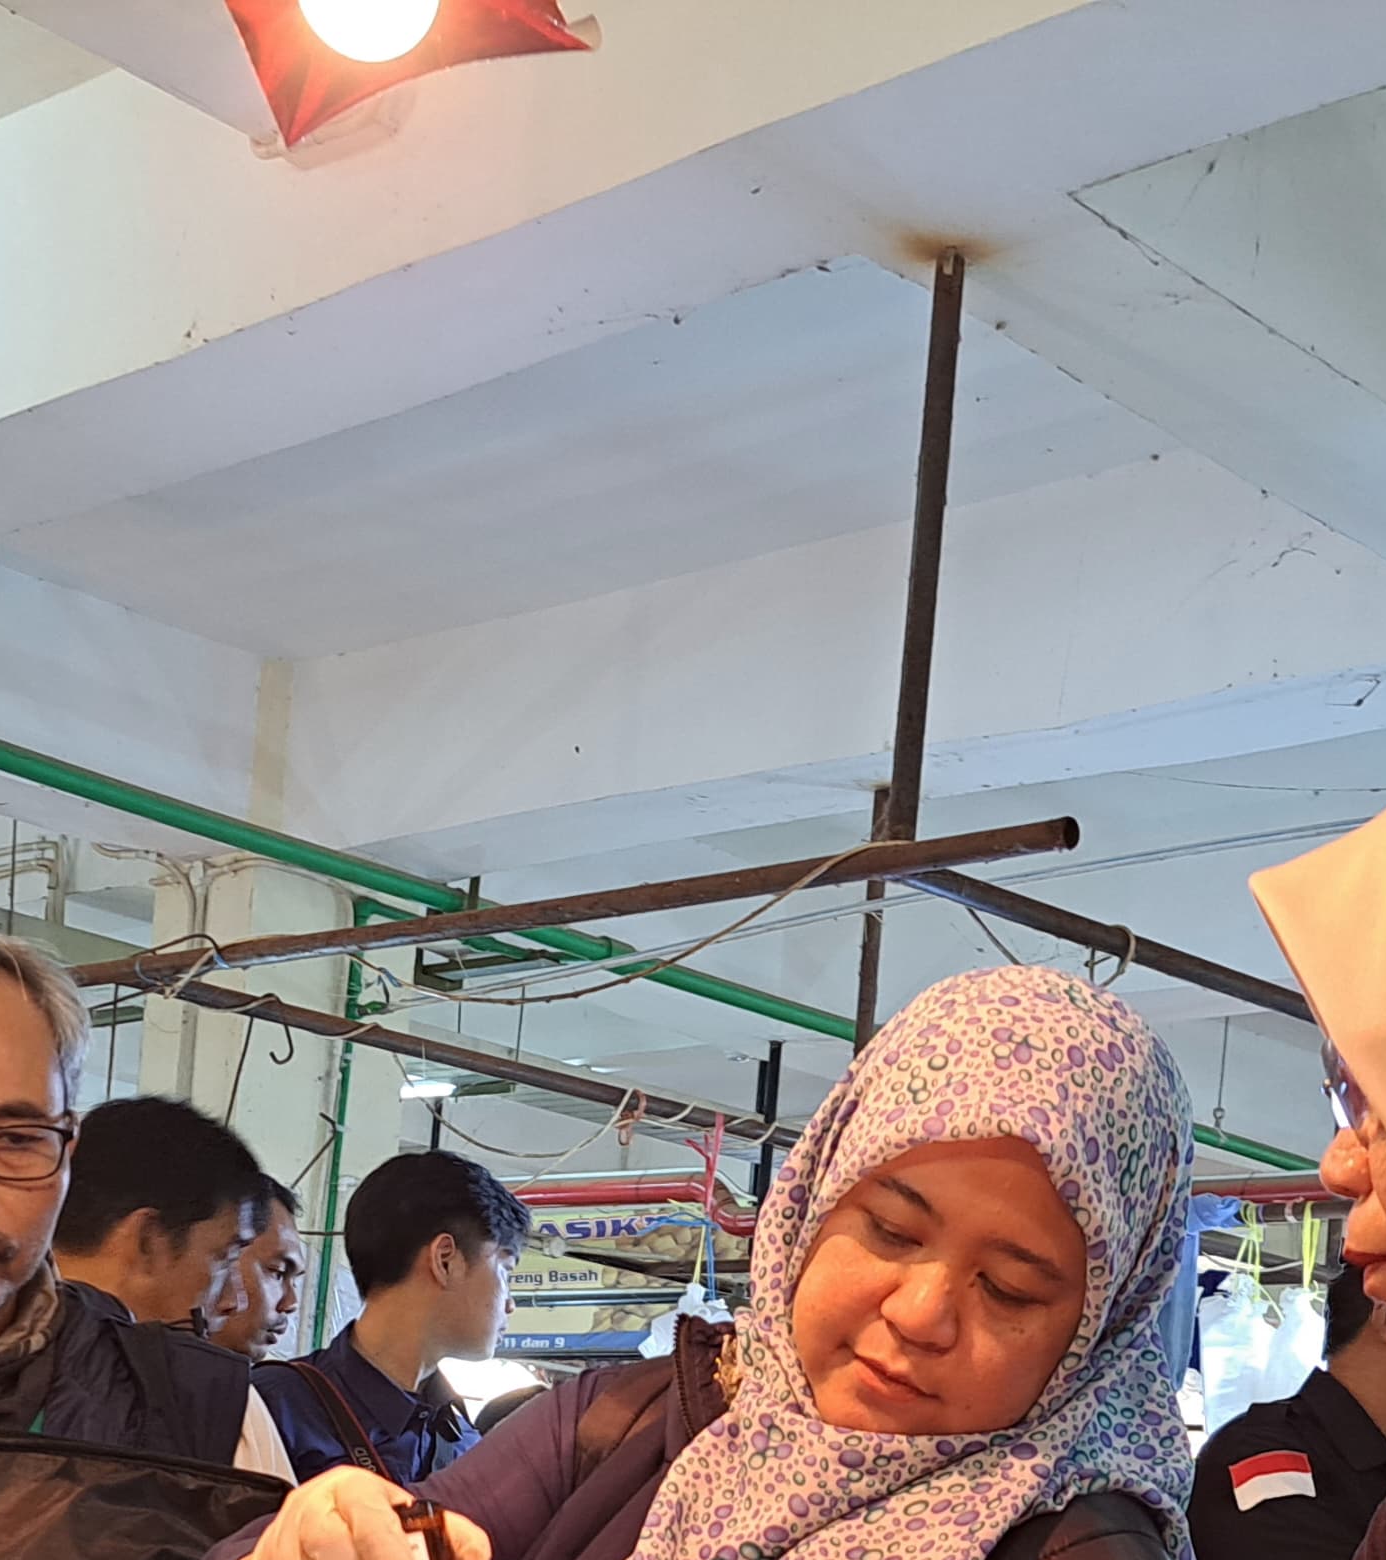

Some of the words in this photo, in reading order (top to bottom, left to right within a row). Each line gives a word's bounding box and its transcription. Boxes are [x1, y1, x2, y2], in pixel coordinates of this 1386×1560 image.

[548, 1270, 598, 1282] Basah
[521, 1337, 549, 1348] dan
[554, 1336, 565, 1348] 9
